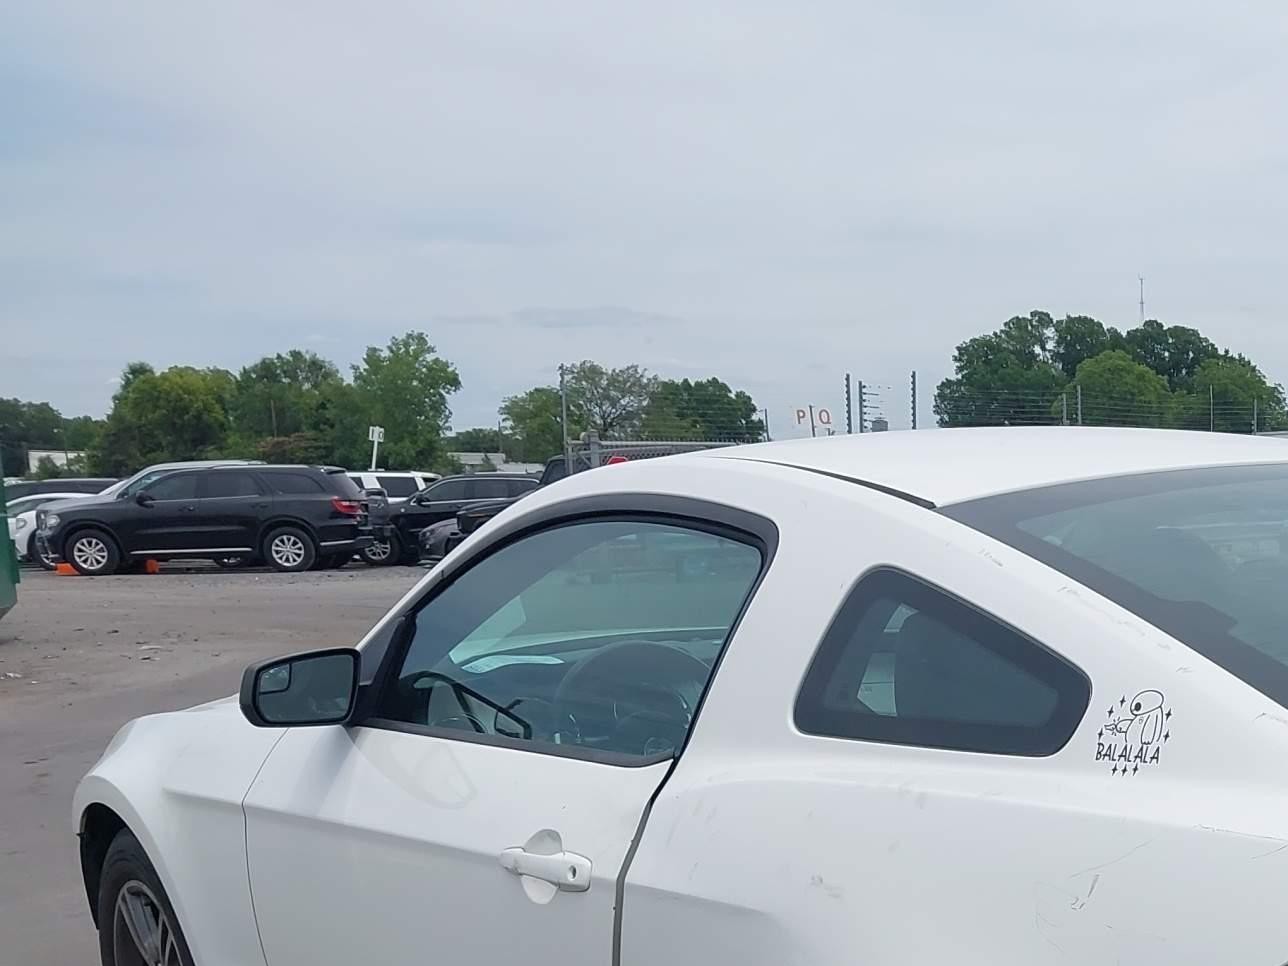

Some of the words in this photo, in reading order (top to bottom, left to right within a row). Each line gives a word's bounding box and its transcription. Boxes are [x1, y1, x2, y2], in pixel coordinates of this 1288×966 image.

[796, 409, 806, 425] P
[818, 409, 832, 425] Q
[1095, 742, 1161, 765] BALALALA
